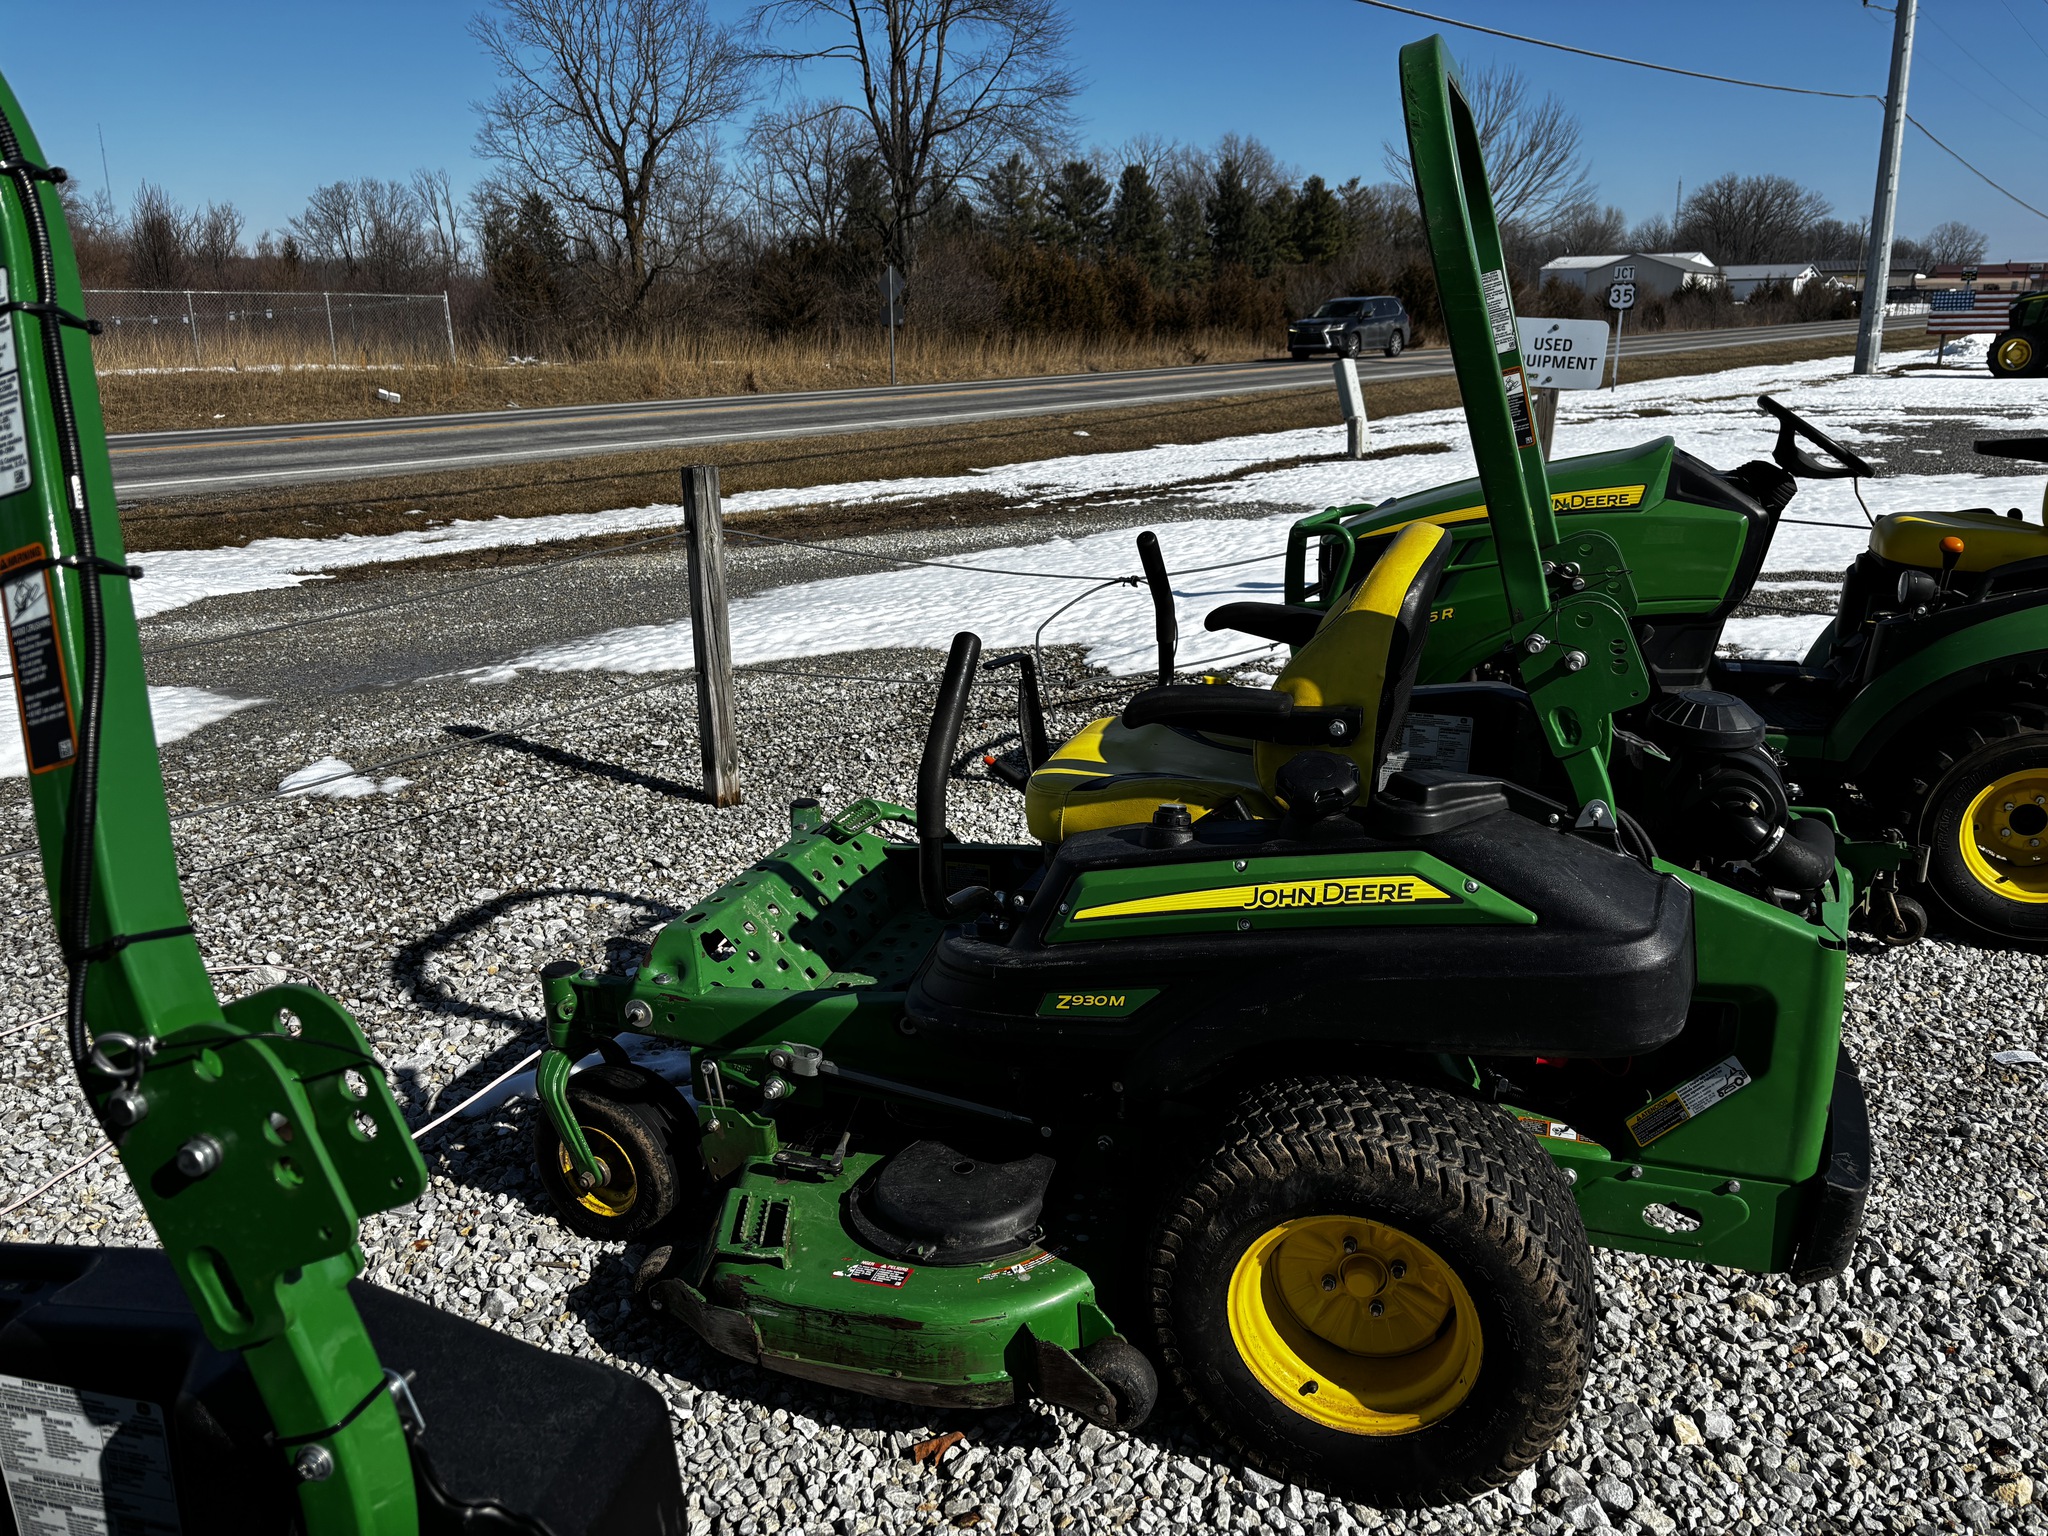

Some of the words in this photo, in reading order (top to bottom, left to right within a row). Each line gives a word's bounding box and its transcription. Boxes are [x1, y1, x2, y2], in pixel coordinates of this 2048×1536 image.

[1614, 267, 1635, 279] JCT
[1611, 289, 1633, 303] 35
[1534, 337, 1573, 352] USED
[1522, 354, 1598, 371] UIPMENT
[1571, 494, 1629, 508] DEERE
[1244, 887, 1316, 907] JOHN
[1323, 883, 1414, 903] DEERE
[1056, 995, 1125, 1009] Z930M
